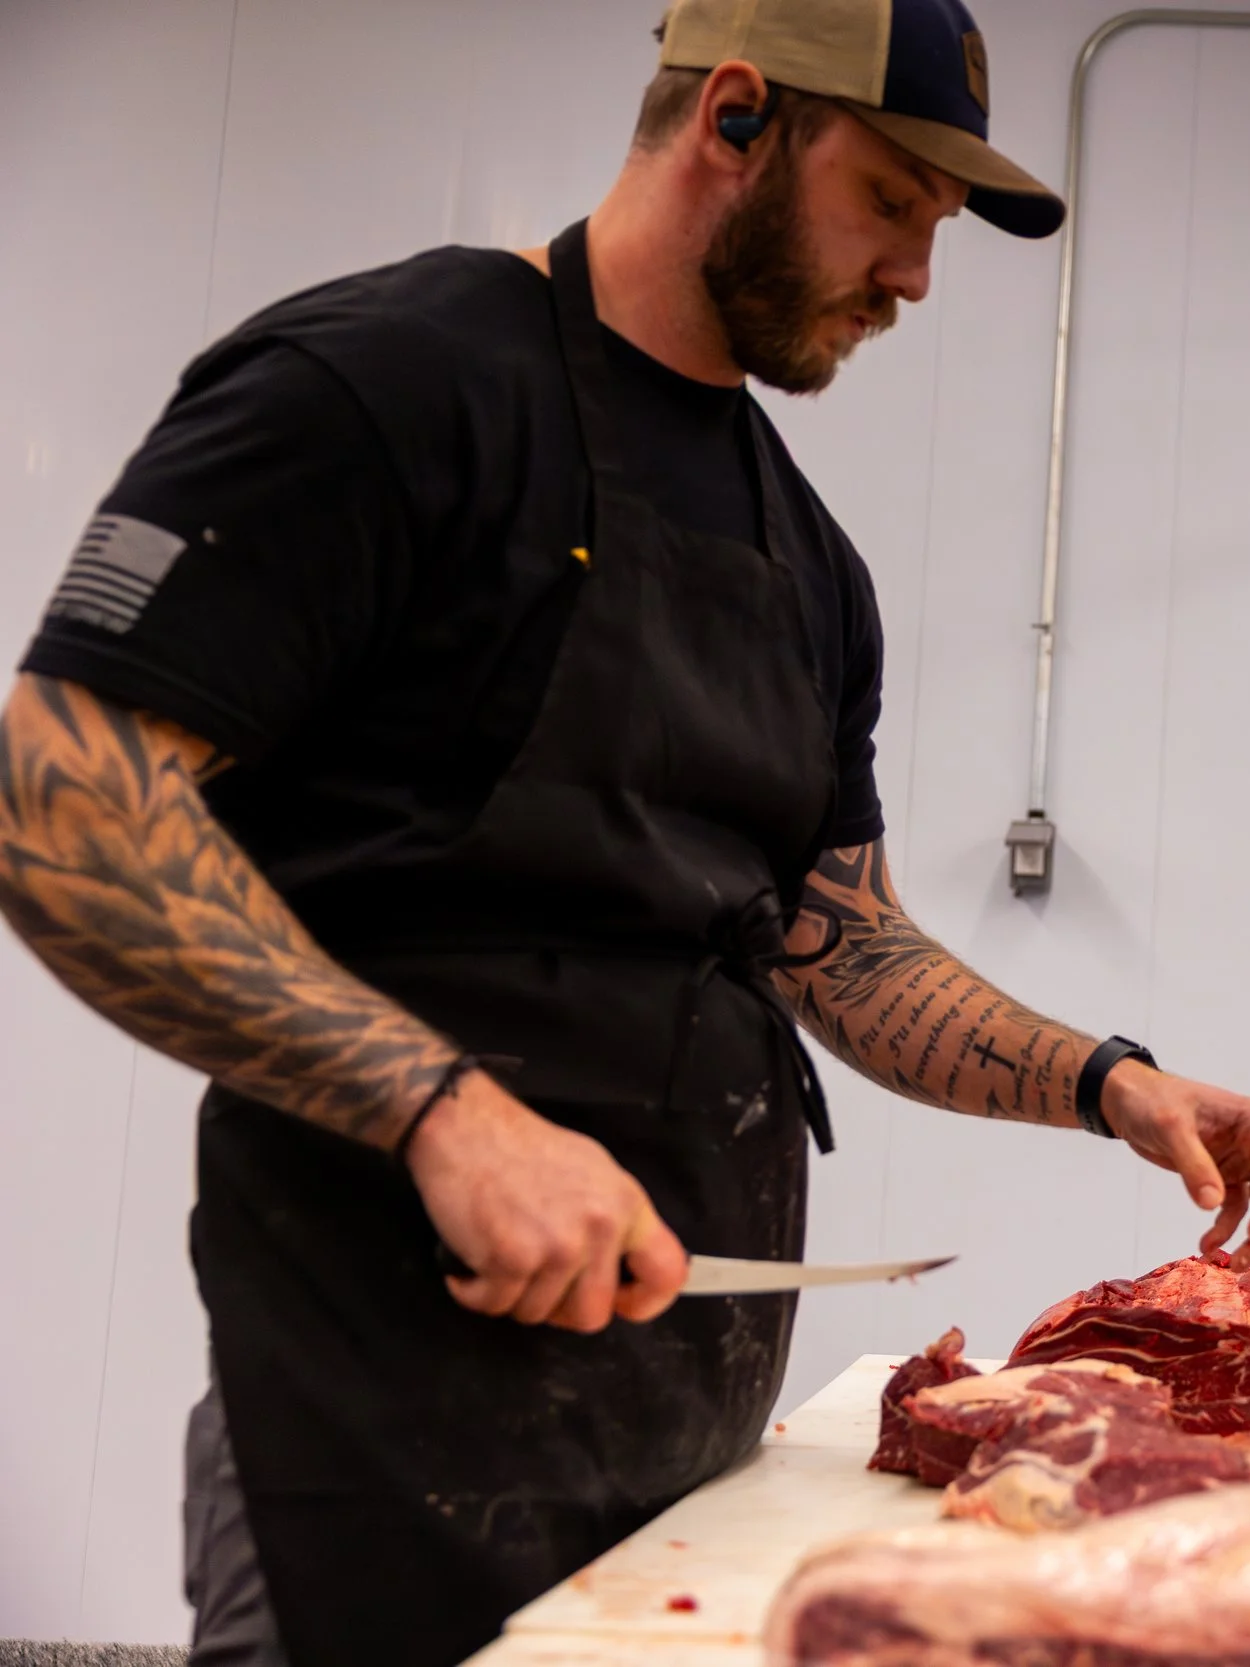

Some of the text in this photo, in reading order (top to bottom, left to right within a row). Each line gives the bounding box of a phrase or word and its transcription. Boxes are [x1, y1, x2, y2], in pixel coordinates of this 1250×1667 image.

[858, 1028, 880, 1056] I'll
[878, 991, 905, 1027] show
[906, 967, 929, 990] you
[887, 1025, 911, 1059] I'll
[910, 991, 936, 1026] show
[915, 1004, 961, 1081] everything
[960, 1026, 980, 1061] wide
